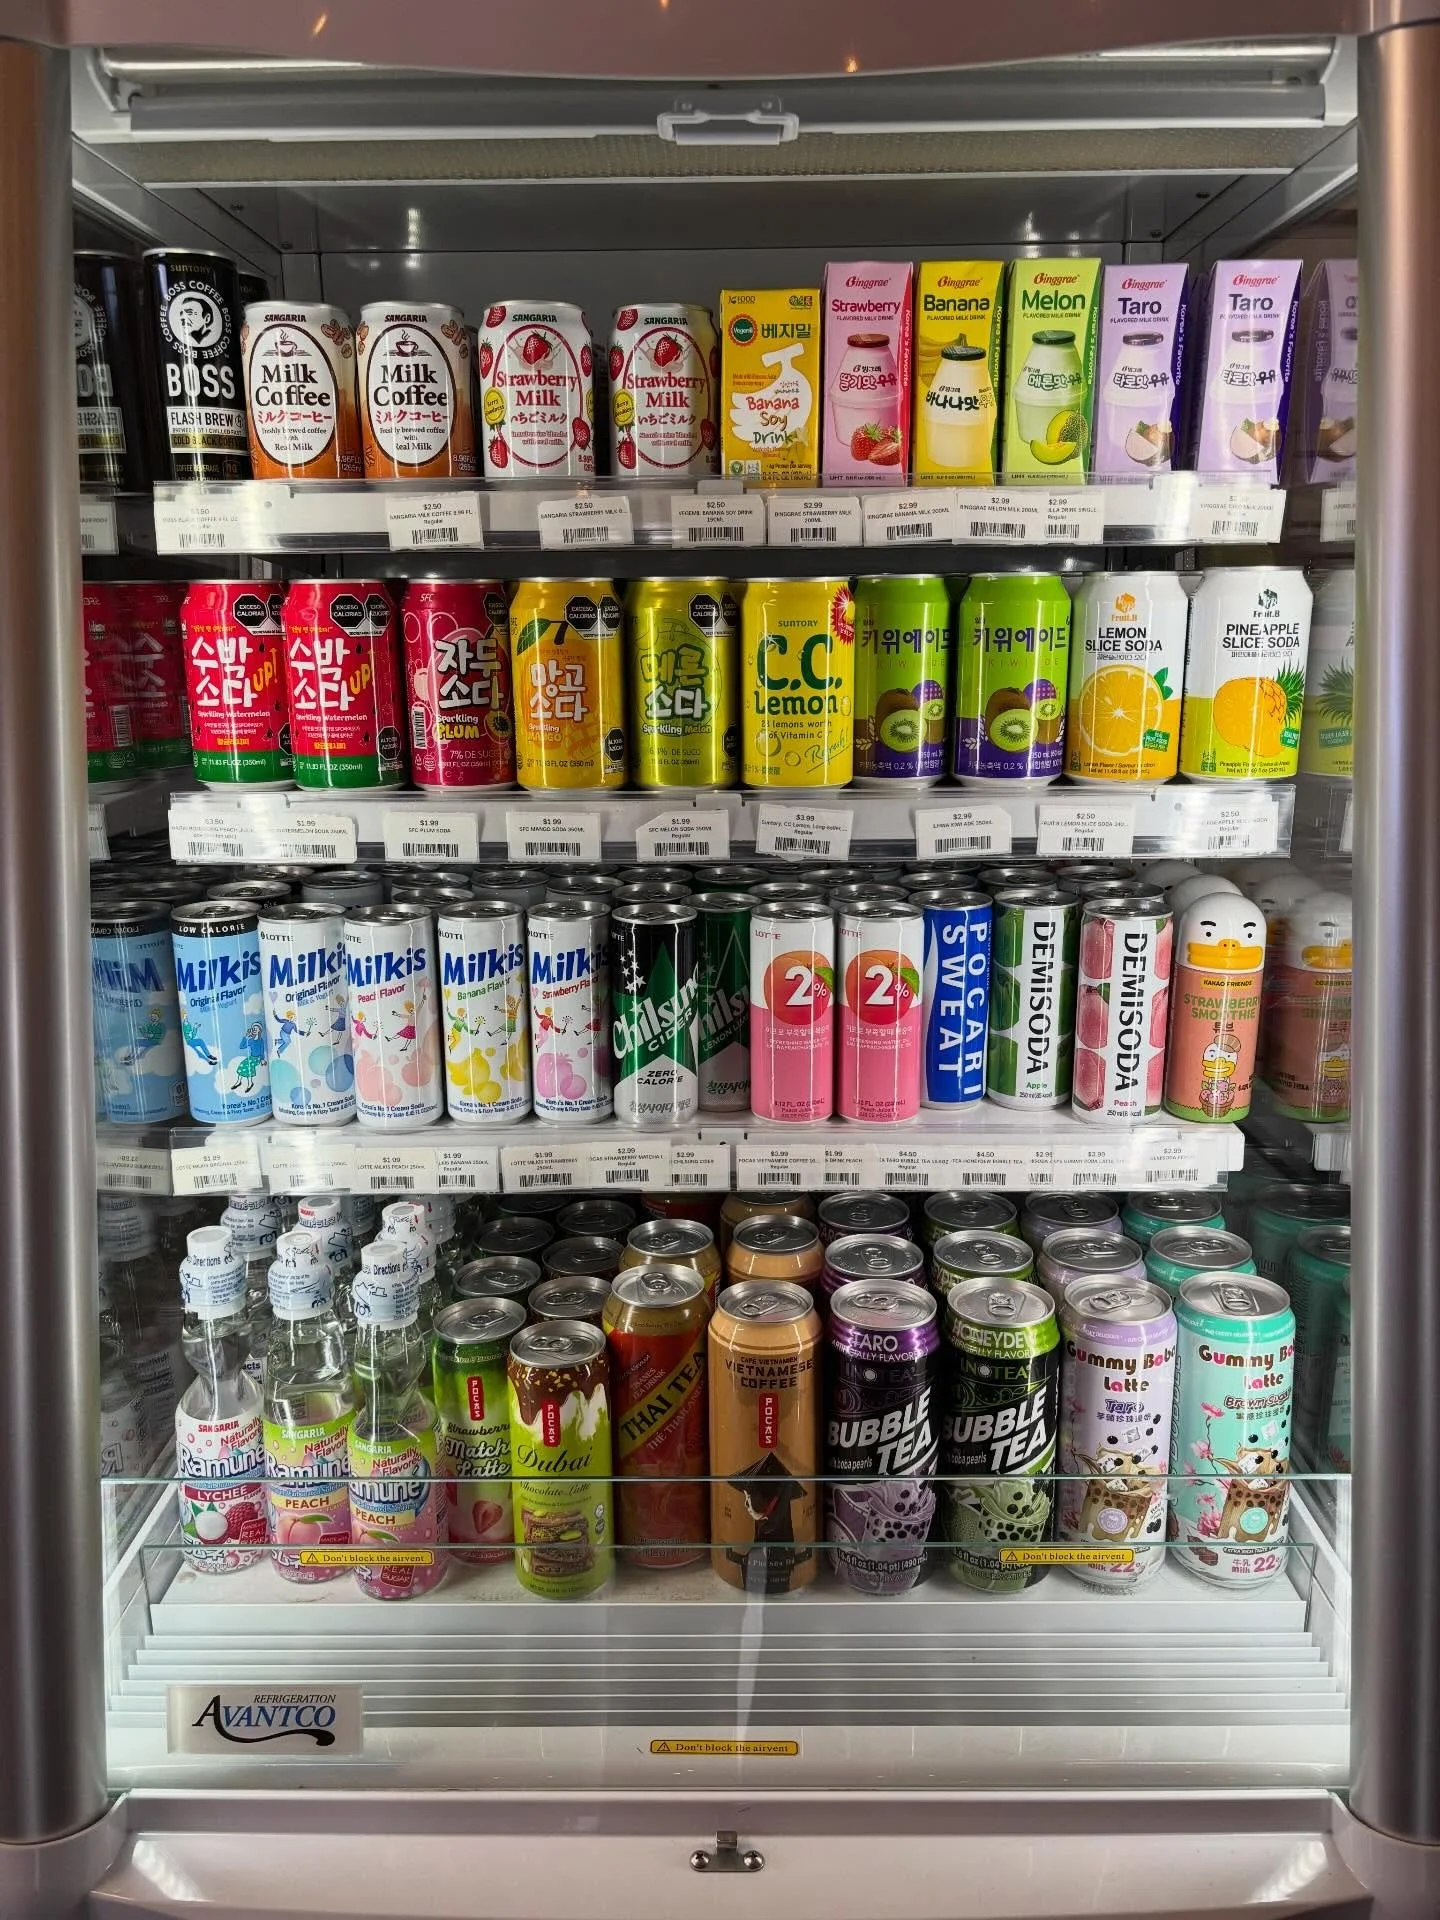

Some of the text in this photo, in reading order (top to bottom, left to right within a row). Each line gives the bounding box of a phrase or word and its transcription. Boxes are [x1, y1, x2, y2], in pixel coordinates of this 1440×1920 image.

[832, 299, 900, 313] Strawberry
[924, 294, 990, 311] Banana
[1022, 290, 1086, 311] Melon
[1118, 298, 1162, 315] Taro
[1229, 294, 1274, 311] Taro
[264, 314, 306, 323] SANGARIA
[385, 314, 427, 323] SANGARIA
[512, 314, 557, 323] SANGARIA
[644, 316, 688, 326] SANGARIA
[761, 324, 811, 339] 베지밀
[1284, 300, 1299, 383] Korea's Favorite
[1175, 304, 1187, 386] Korea's Favorite
[166, 363, 236, 400] BOSS
[262, 364, 318, 384] Milk
[381, 364, 438, 384] Milk
[497, 370, 578, 392] Strawberry
[626, 372, 706, 394] Strawberry
[1113, 373, 1170, 390] 타로맛우유
[255, 387, 331, 407] Coffee
[373, 385, 448, 406] Coffee
[515, 390, 561, 407] Milk
[646, 392, 690, 408] Milk
[746, 396, 800, 411] Banana
[257, 411, 333, 423] ミルクコーヒー
[375, 410, 449, 424] ミルクコーヒー
[510, 412, 568, 425] いちごミルク
[638, 415, 697, 426] いちごミルク
[760, 411, 788, 431] Soy
[401, 426, 425, 434] brewed
[275, 443, 313, 451] Real Milk
[420, 594, 434, 602] SFC
[1098, 627, 1147, 639] LEMON
[1226, 623, 1300, 636] PINEAPPLE
[973, 628, 1067, 653] 키위에이드
[1085, 640, 1163, 652] SLICE SODA
[1223, 637, 1300, 649] SLICE SODA
[192, 637, 253, 679] 수박
[290, 637, 350, 681] 수박
[435, 638, 501, 677] 자두
[640, 643, 709, 689] 메론
[757, 633, 842, 690] C.C.
[530, 660, 587, 697] 망고
[196, 675, 258, 708] 소다
[294, 678, 355, 711] 소다
[438, 675, 504, 709] 소다
[529, 692, 589, 722] 소다
[646, 685, 710, 719] 소다
[754, 690, 838, 716] Lemon
[437, 725, 480, 740] PLUM
[685, 725, 711, 734] Melon
[781, 731, 814, 739] Vitamin
[179, 923, 245, 934] LOW CALORIE
[177, 951, 261, 993] Milkis
[347, 947, 426, 987] Milkis
[443, 943, 524, 987] Milkis
[784, 966, 827, 1006] 2%
[864, 964, 910, 1006] 2%
[939, 924, 966, 1078] SWEAT
[1026, 921, 1056, 1074] DEMISODA
[964, 922, 988, 1095] POCARI
[1115, 933, 1147, 1092] DEMISODA
[647, 1008, 693, 1051] CIDER
[637, 1076, 683, 1085] CALORIE
[647, 1070, 677, 1078] ZERO
[1026, 1081, 1048, 1090] Apple
[1114, 1100, 1137, 1108] Peach
[725, 1360, 814, 1379] VIETNAMESE
[740, 1377, 797, 1389] COFFEE
[1104, 1376, 1150, 1392] Latte
[471, 1380, 481, 1418] POCAS
[621, 1352, 705, 1441] THAI TEA
[547, 1404, 556, 1443] POCAS
[764, 1397, 774, 1445] POCAS
[828, 1387, 931, 1447] BUBBLE
[876, 1429, 932, 1476] TEA
[990, 1421, 1048, 1474] TEA
[372, 1446, 421, 1477] Naturally Flavored
[457, 1459, 511, 1478] Latte
[517, 1444, 593, 1473] Dubai
[197, 1485, 248, 1502] LYCHEE
[285, 1496, 330, 1510] PEACH
[355, 1508, 396, 1526] PEACH
[323, 1553, 425, 1563] Don't block the airvent
[1023, 1552, 1125, 1561] Don't block the airvent
[254, 1694, 336, 1703] REFRIGERATION
[192, 1694, 336, 1738] AVANTCO
[676, 1743, 702, 1751] Don't
[705, 1743, 732, 1752] block
[735, 1744, 750, 1752] the
